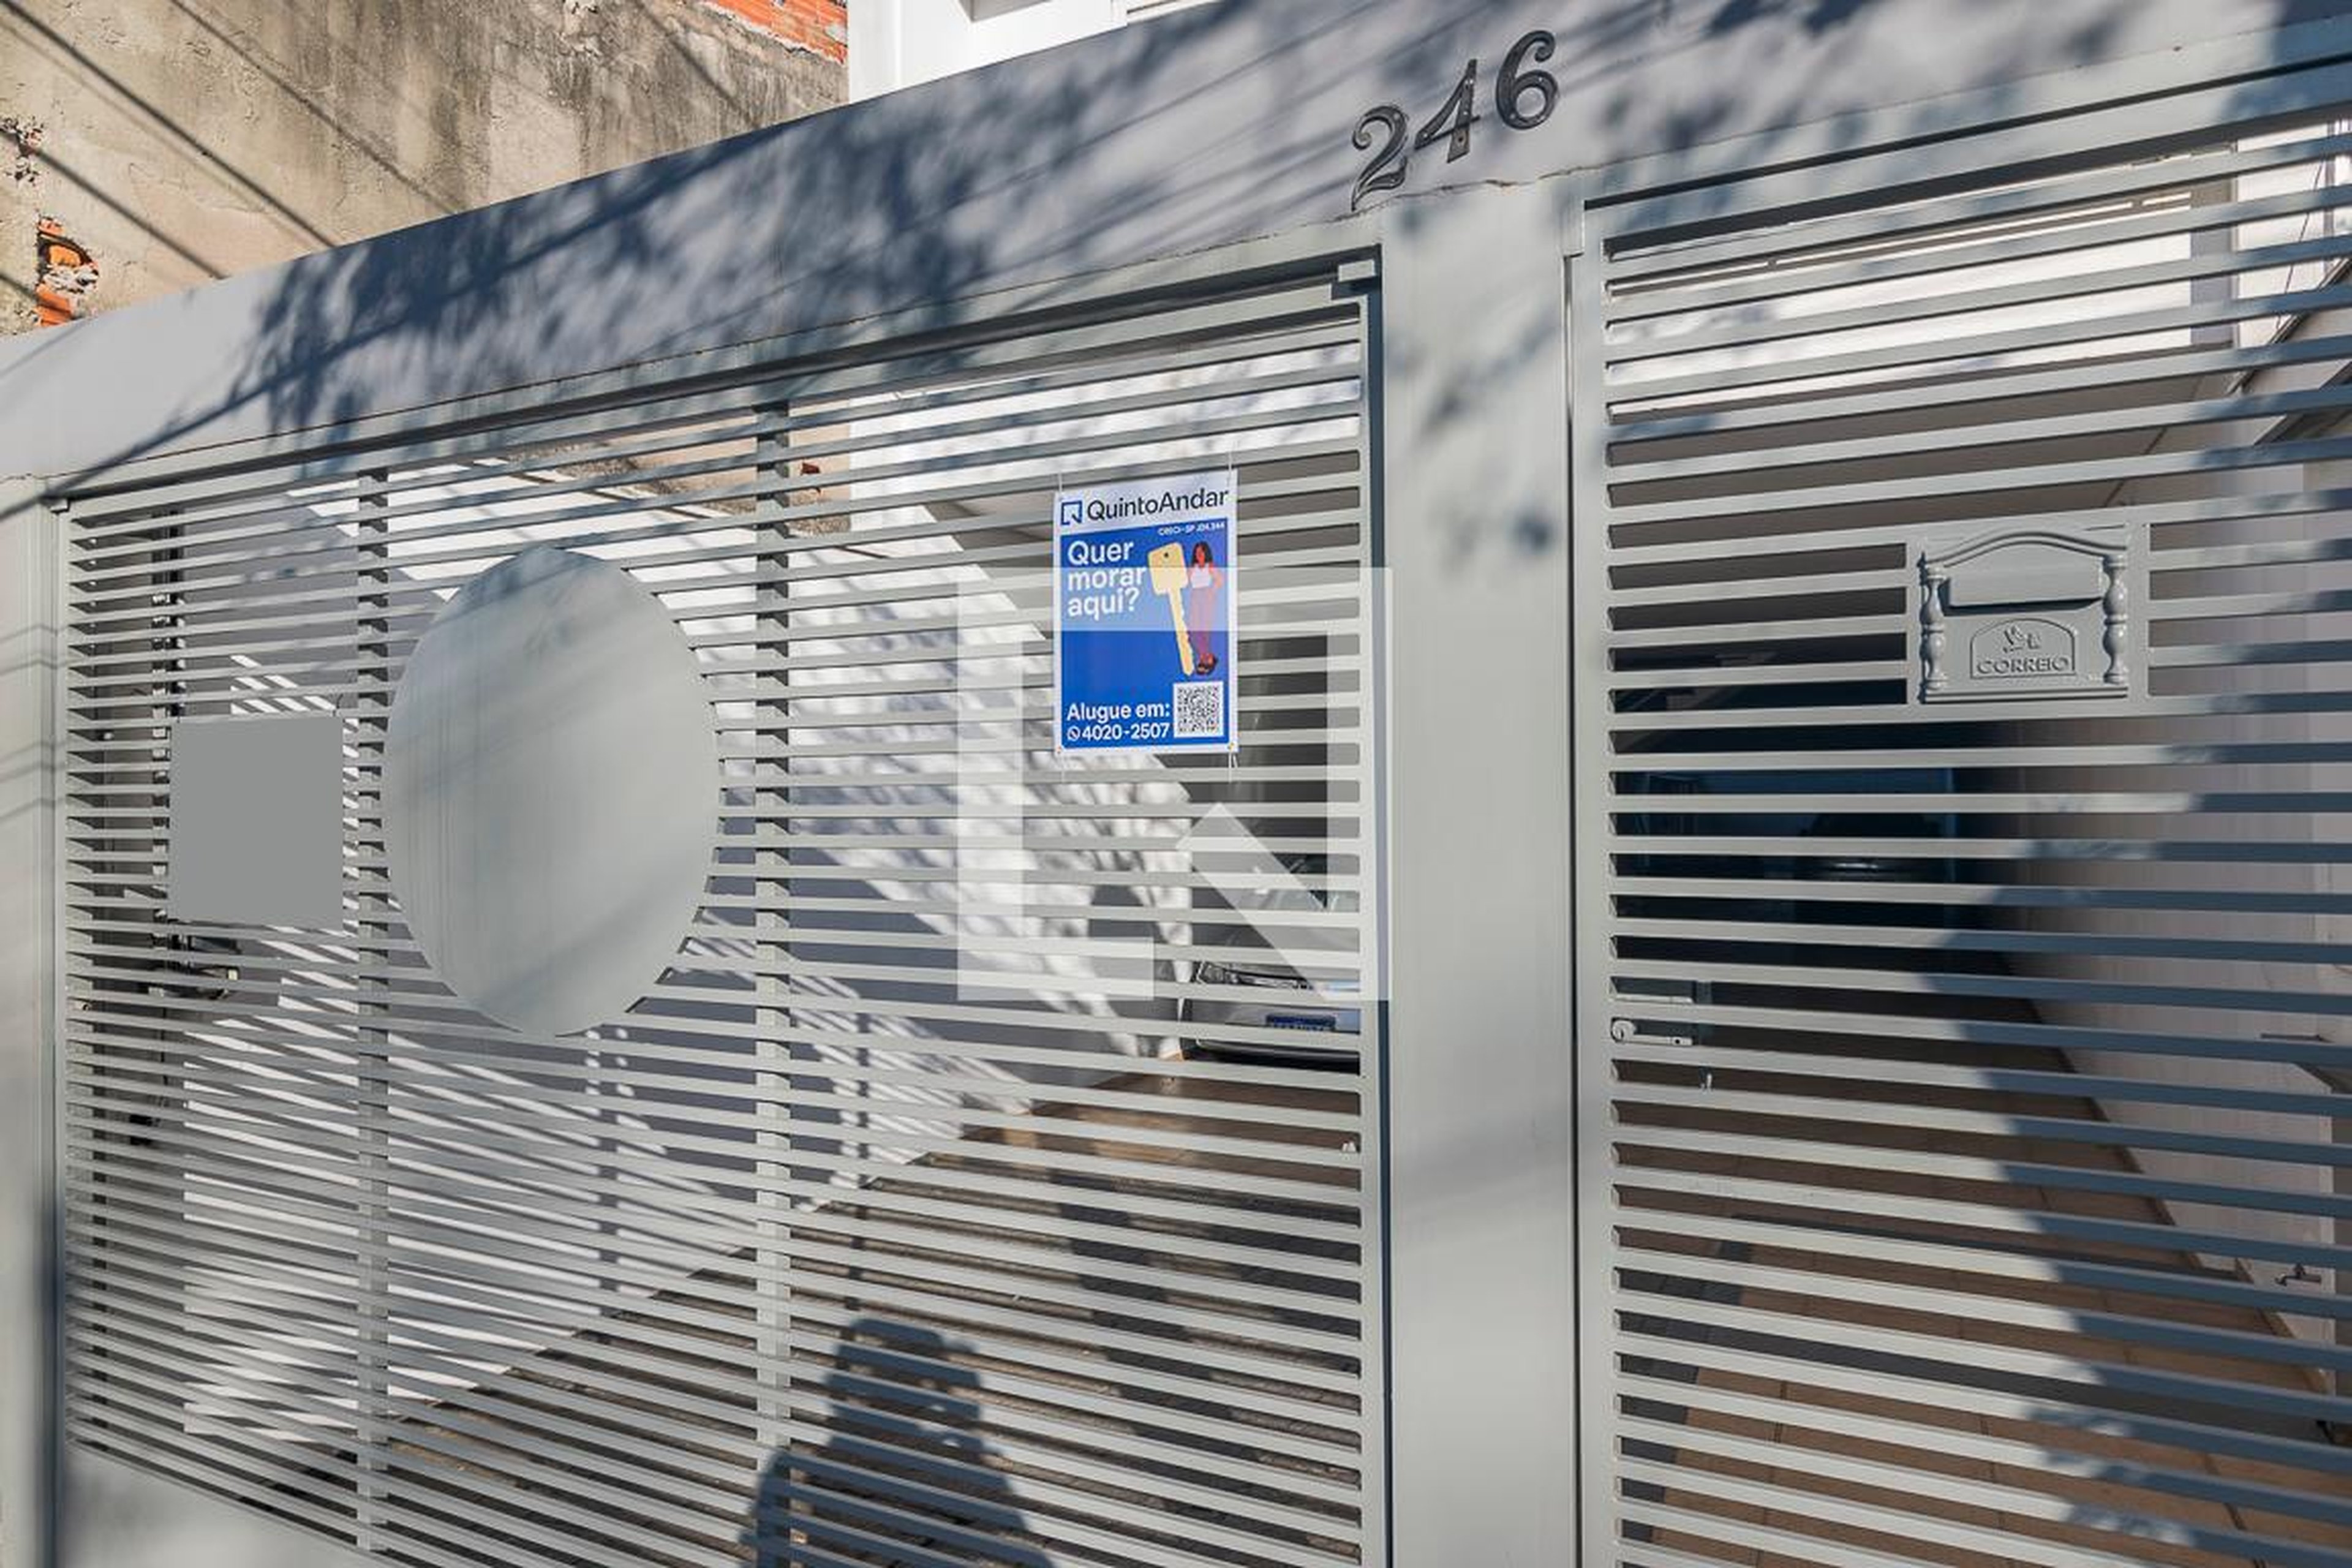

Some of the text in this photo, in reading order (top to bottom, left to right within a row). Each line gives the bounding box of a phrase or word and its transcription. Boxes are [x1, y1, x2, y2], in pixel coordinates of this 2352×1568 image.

[1352, 30, 1559, 211] 246
[1087, 488, 1229, 521] QuintoAndar
[1068, 540, 1134, 565] Quer
[1068, 567, 1146, 591] morar
[1068, 587, 1139, 621] aqui?
[1977, 656, 2069, 674] CORREIO
[1067, 703, 1170, 723] Alugue em:
[1082, 723, 1170, 741] 4020-2507
